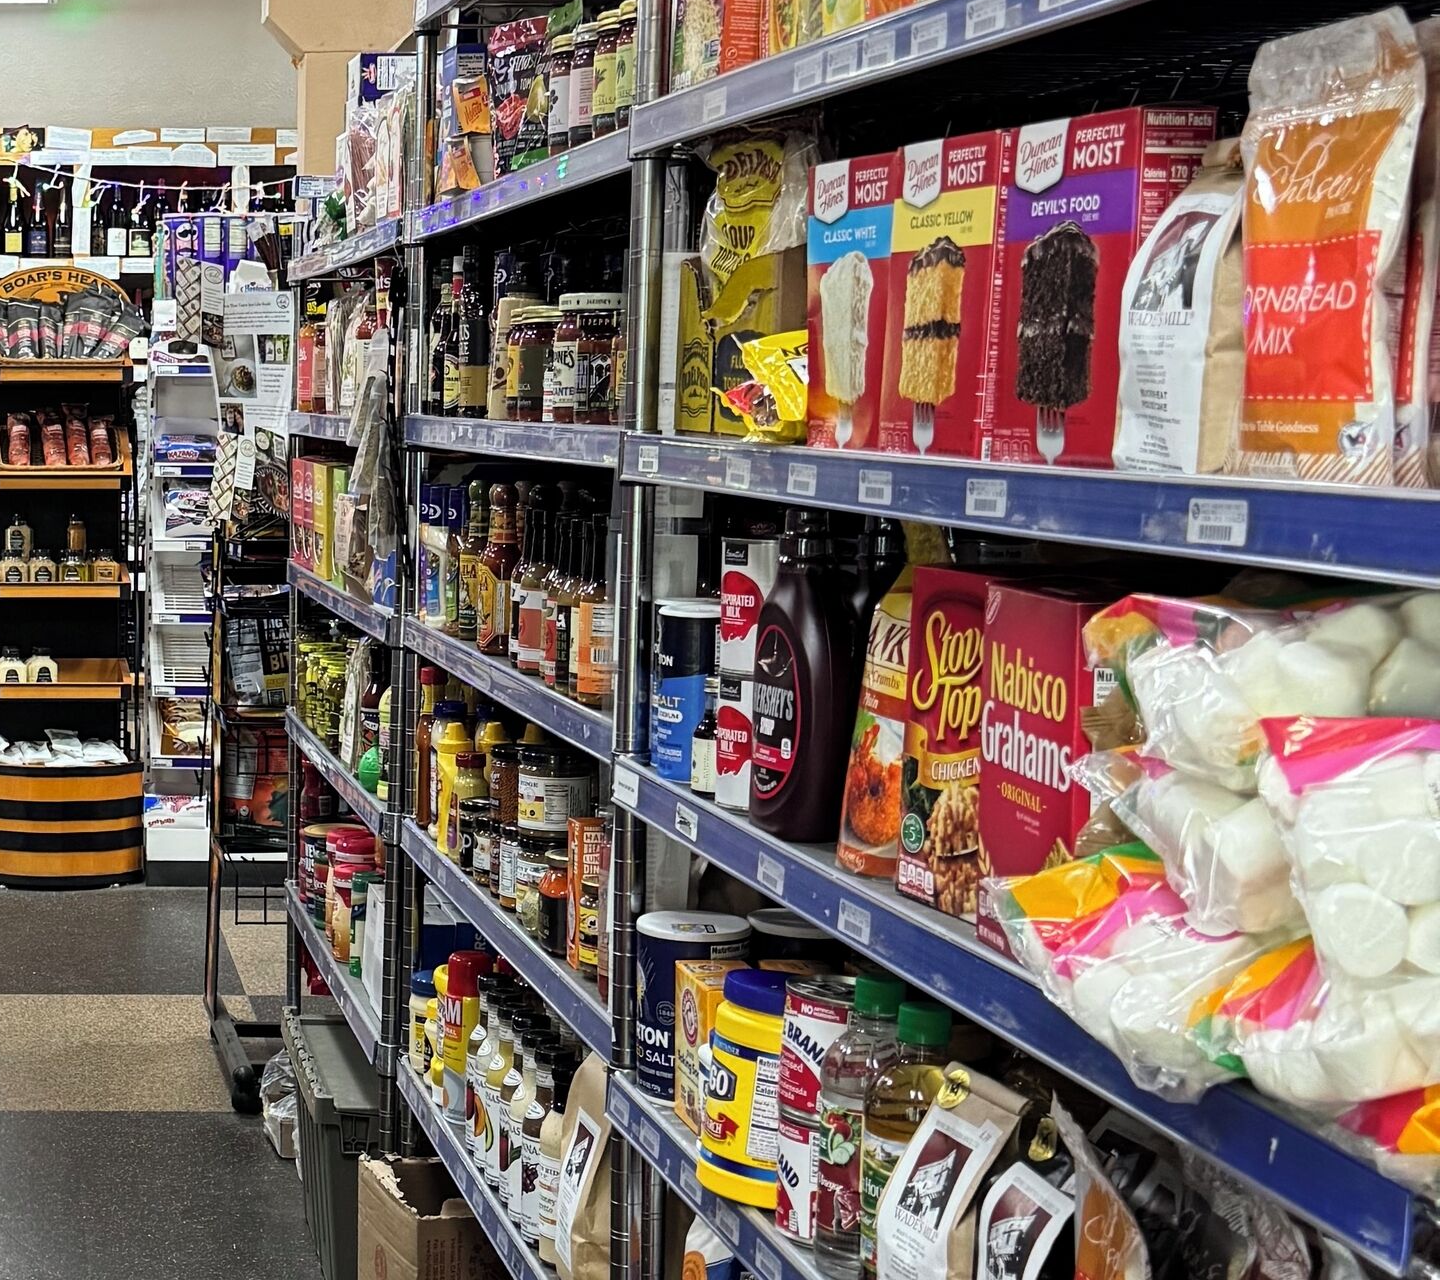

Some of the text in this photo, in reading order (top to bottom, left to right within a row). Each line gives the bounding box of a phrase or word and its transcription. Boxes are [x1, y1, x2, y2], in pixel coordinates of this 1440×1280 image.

[1147, 111, 1213, 128] Nutrition Facts
[1075, 123, 1125, 144] PERFECTLY
[949, 146, 987, 164] PERFECTLY
[1021, 133, 1063, 165] Duncan
[1073, 141, 1124, 170] MOIST
[855, 166, 889, 185] PERFECTLY
[908, 153, 939, 180] Duncan
[948, 161, 986, 186] MOIST
[1025, 152, 1059, 183] Hines
[1170, 165, 1188, 180] 170
[817, 173, 847, 196] Duncan
[855, 181, 888, 206] MOIST
[913, 170, 938, 199] Hines
[821, 189, 845, 215] Hines
[1031, 195, 1101, 218] DEVIL'S FOOD
[911, 210, 974, 230] CLASSIC YELLOW
[824, 225, 877, 244] CLASSIC WHITE
[2, 270, 63, 294] BOAR'S
[1245, 280, 1357, 315] ORNBREAD
[991, 642, 1067, 723] Nabisco
[981, 699, 1071, 793] Grahams
[1001, 784, 1042, 812] ORIGINAL
[801, 1003, 814, 1015] NO
